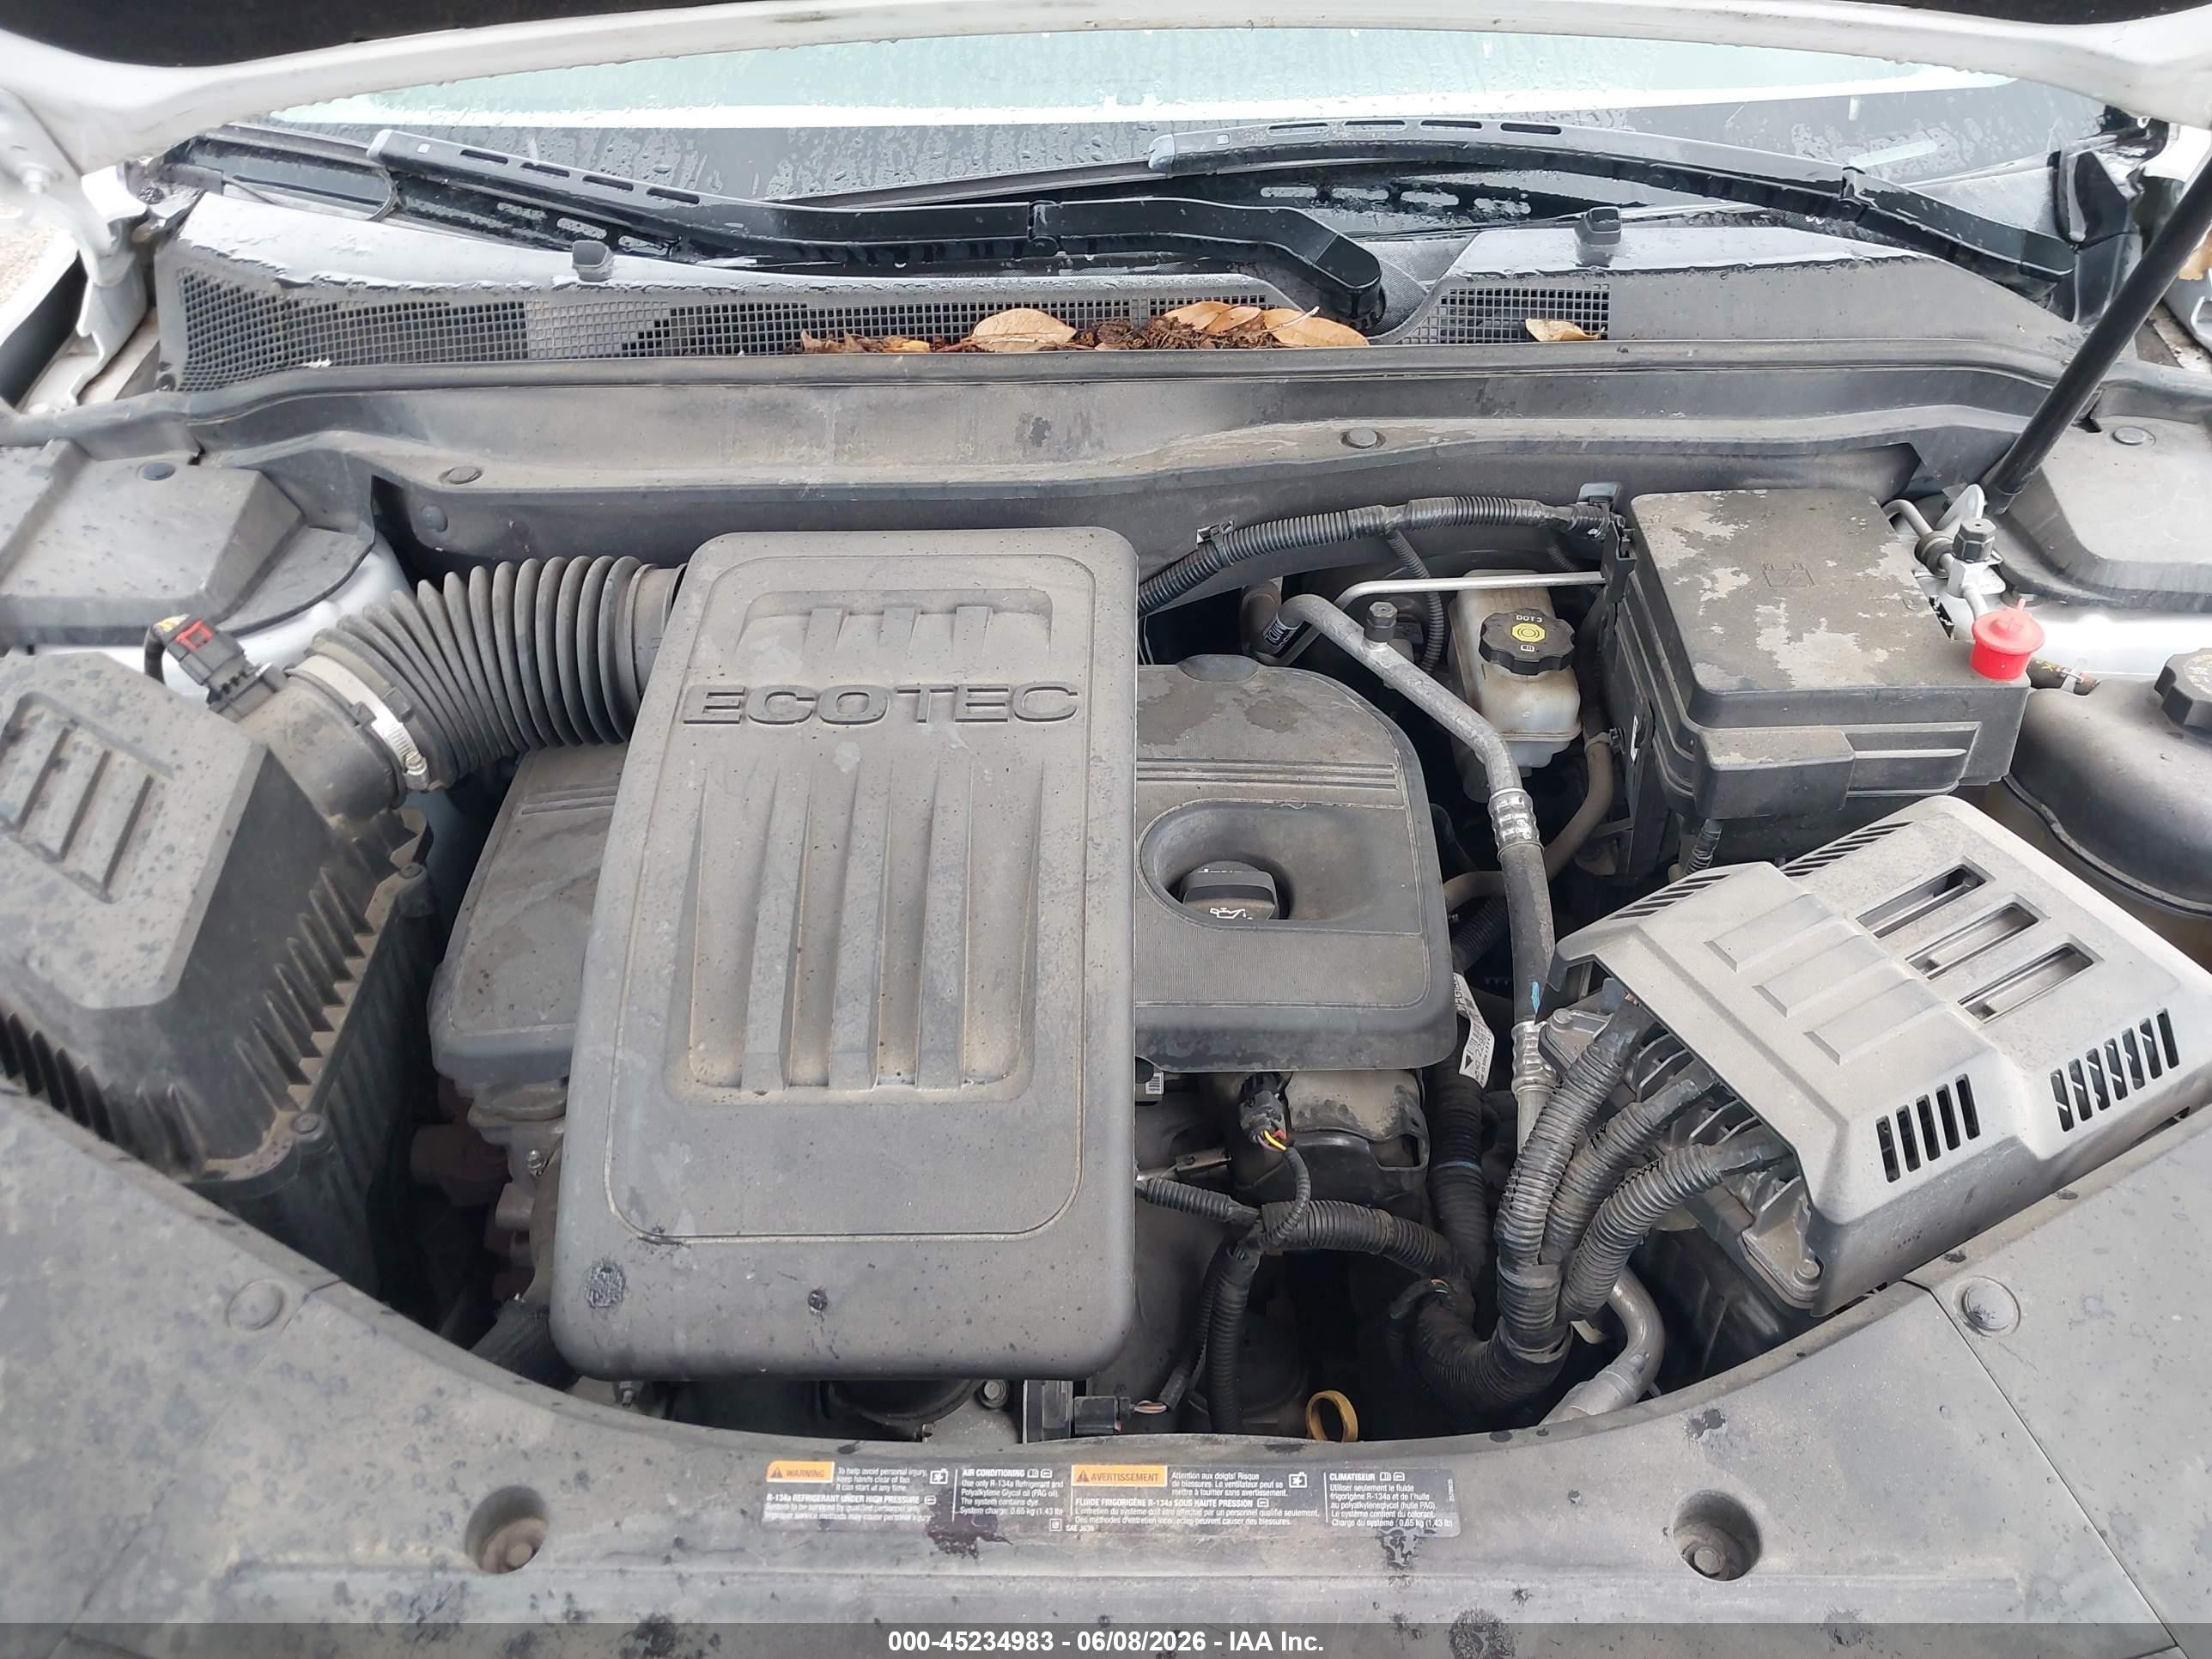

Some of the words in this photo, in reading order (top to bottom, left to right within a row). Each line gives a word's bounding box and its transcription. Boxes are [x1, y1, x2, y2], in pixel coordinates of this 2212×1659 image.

[683, 682, 1079, 725] ECOTEC
[838, 1467, 845, 1475] To
[847, 1468, 860, 1476] help
[880, 1468, 907, 1476] personal
[962, 1468, 975, 1477] AIR
[976, 1468, 1025, 1477] CONDITIONING
[836, 1475, 853, 1484] keep
[1091, 1473, 1159, 1481] AVERTISSEMENT
[1238, 1472, 1260, 1481] Risque
[1329, 1473, 1376, 1481] CLIMATISEUR
[975, 1480, 989, 1489] only
[1015, 1480, 1050, 1489] Refrigerant
[1260, 1480, 1274, 1489] peut
[962, 1488, 1000, 1498] Polyalkylene
[1002, 1489, 1021, 1498] Glycol
[1031, 1489, 1047, 1498] (PAG
[1410, 1492, 1430, 1501] l'huile
[793, 1494, 840, 1503] REFRIGERANT
[842, 1494, 865, 1503] UNDER
[866, 1495, 883, 1504] HIGH
[974, 1498, 997, 1507] system
[1076, 1498, 1099, 1506] FLUIDE
[1101, 1498, 1146, 1507] FRIGORIGÈNE
[1218, 1499, 1253, 1508] PRESSION
[960, 1506, 983, 1516] System
[1027, 1508, 1036, 1516] kg
[1120, 1508, 1147, 1516] système
[1226, 1509, 1258, 1517] personnel
[1284, 1508, 1319, 1516] seulement.
[1341, 1510, 1369, 1519] système
[1332, 1519, 1355, 1528] Charge
[1367, 1519, 1394, 1528] système
